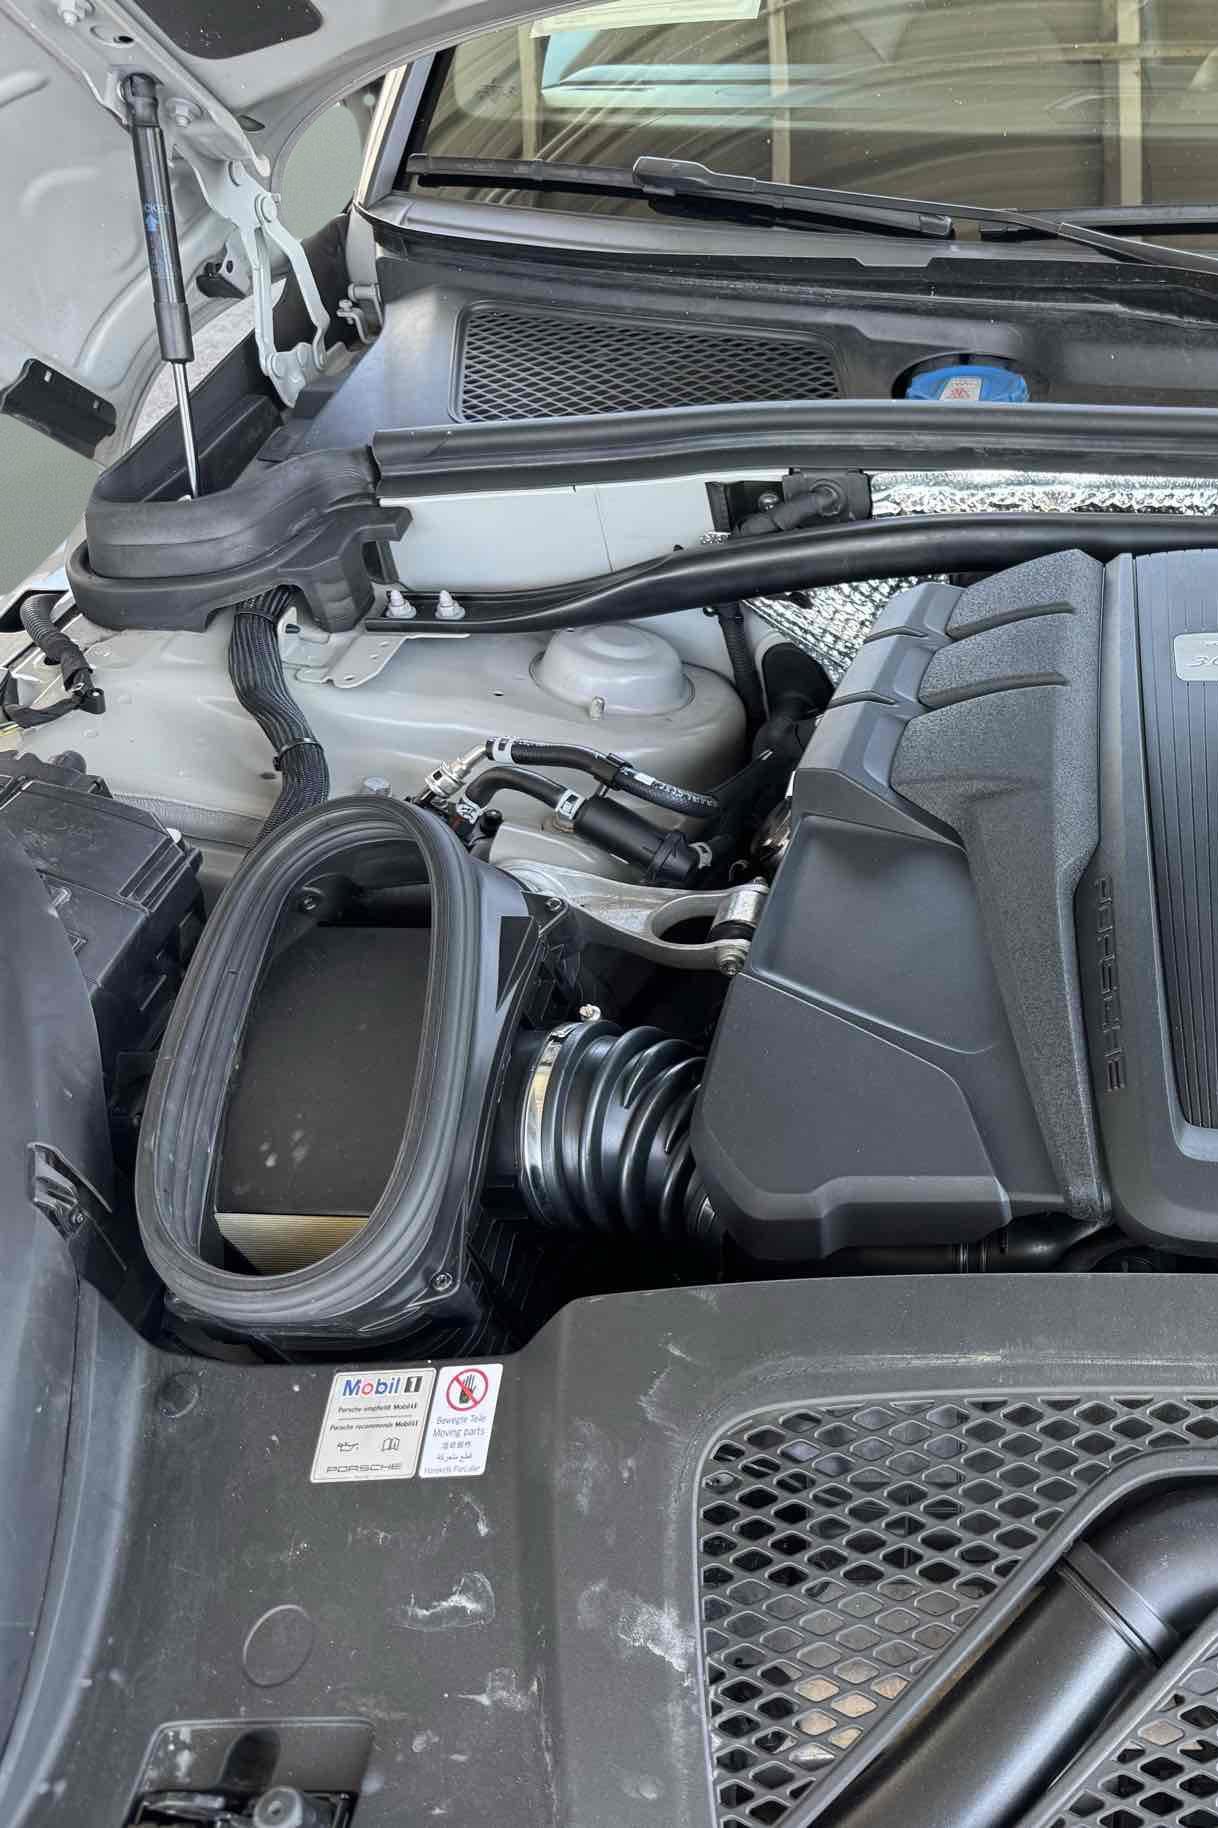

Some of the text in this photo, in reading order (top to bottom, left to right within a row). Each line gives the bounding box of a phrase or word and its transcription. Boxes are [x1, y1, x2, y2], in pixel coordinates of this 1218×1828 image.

[1095, 876, 1127, 1093] PORSCHE
[342, 1376, 423, 1397] Mobil 1
[337, 1406, 362, 1414] Porsche
[436, 1416, 469, 1426] Bewegte
[329, 1423, 354, 1431] Porsche
[433, 1427, 486, 1438] Moving parts
[326, 1462, 402, 1473] PORSCHE
